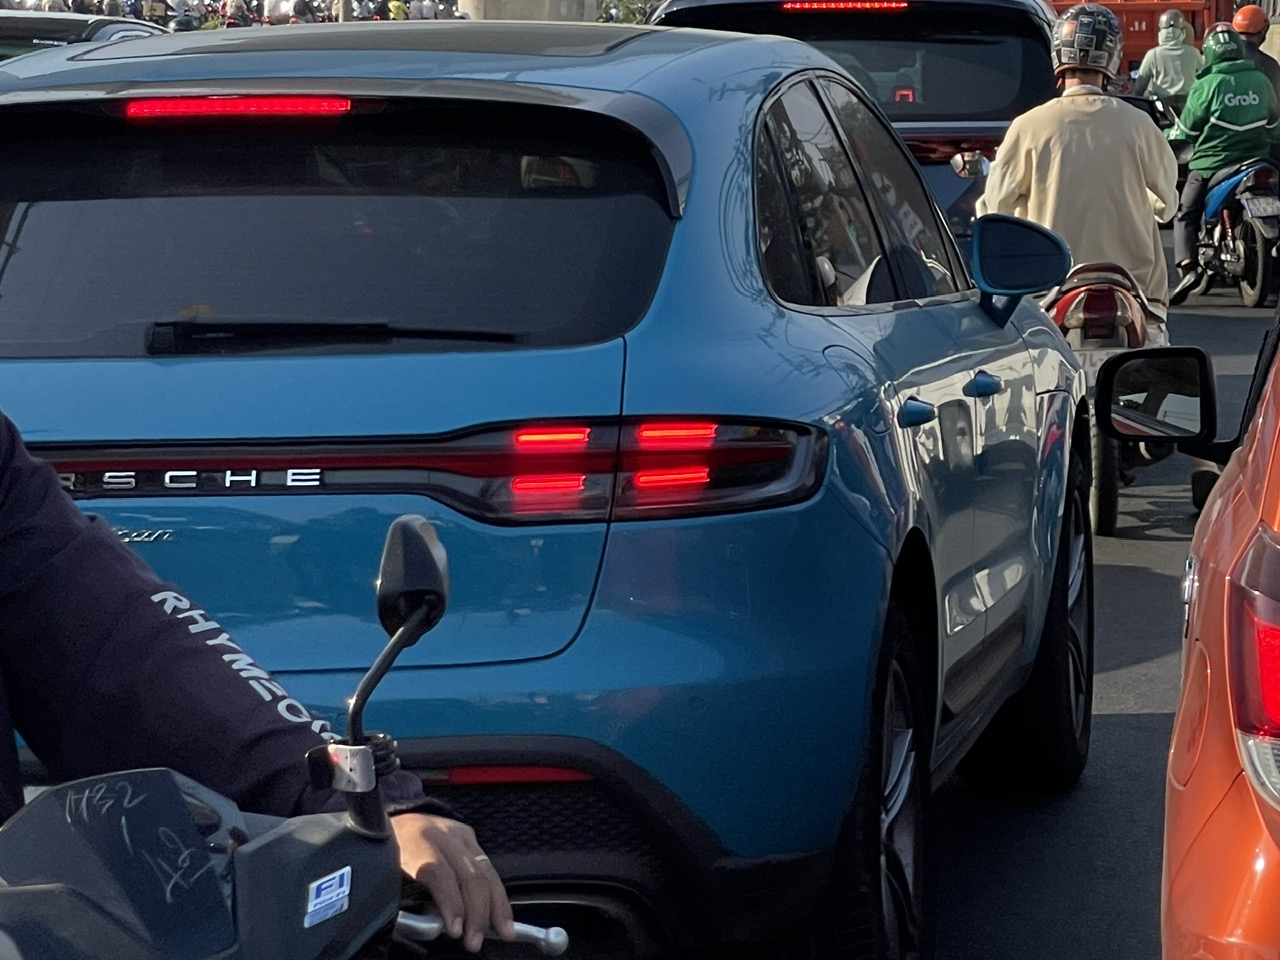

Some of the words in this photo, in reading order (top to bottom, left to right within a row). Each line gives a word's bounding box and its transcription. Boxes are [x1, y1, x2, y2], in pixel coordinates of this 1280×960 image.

[1216, 42, 1238, 52] Grab
[1224, 91, 1260, 107] Grab
[314, 872, 346, 900] FI
